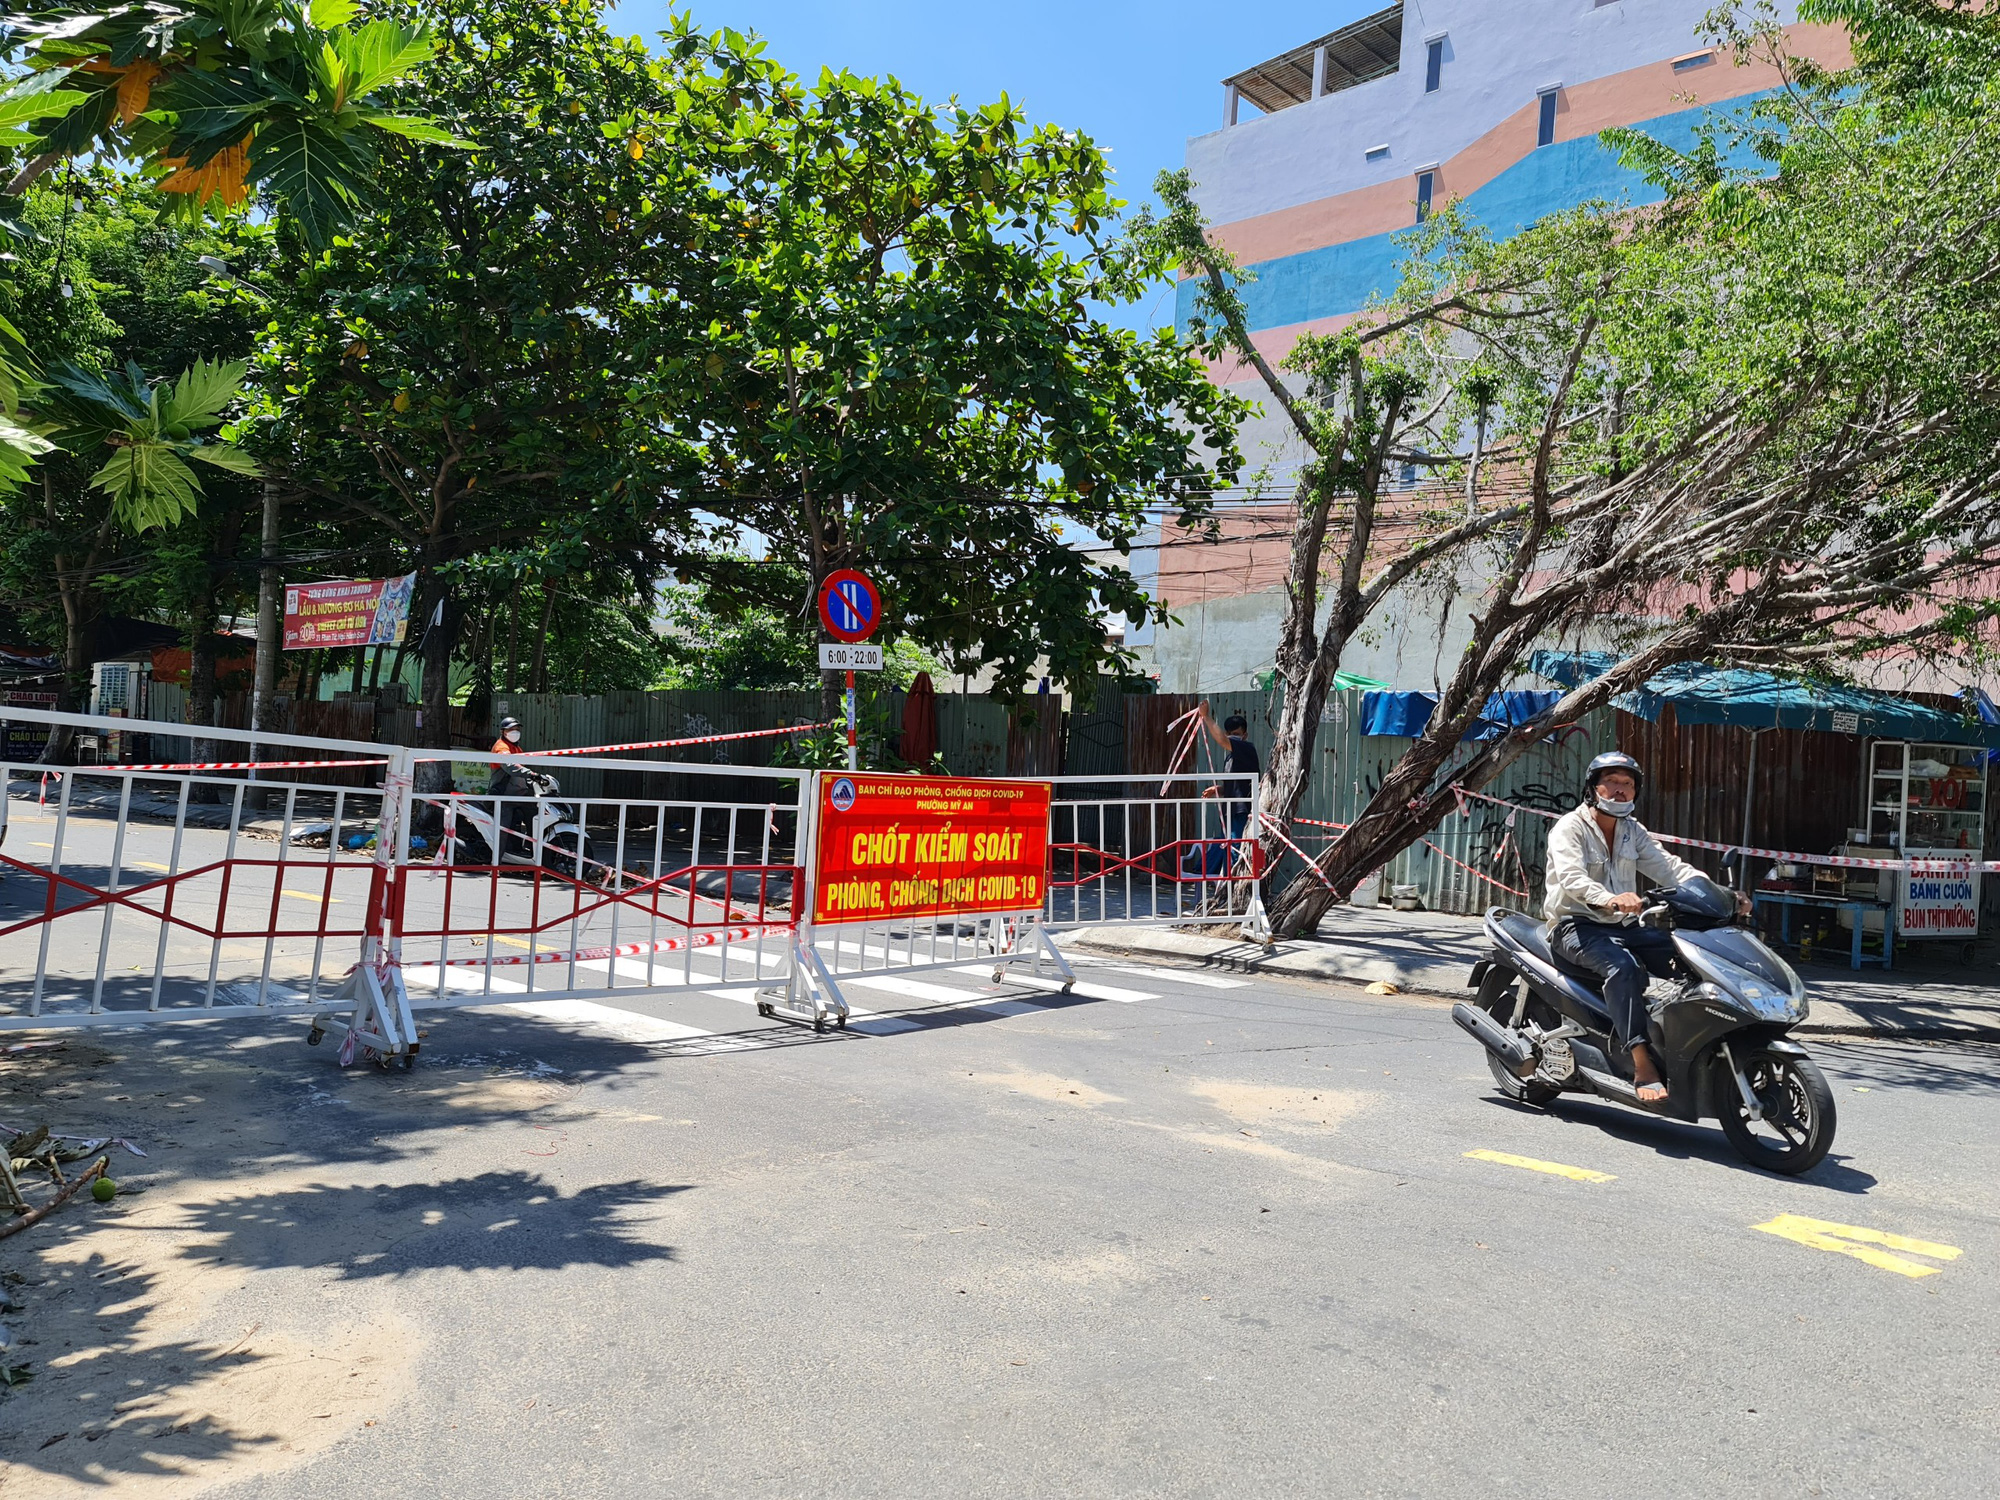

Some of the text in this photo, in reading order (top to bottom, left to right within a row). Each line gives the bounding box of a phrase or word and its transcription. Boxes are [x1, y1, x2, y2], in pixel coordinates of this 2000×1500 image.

[829, 650, 846, 663] 6:00
[855, 651, 877, 664] 22:00
[858, 783, 1024, 799] BAN CHỈ ĐẠO PHÒNG, CHỐNG DỊCH COVID-19
[916, 799, 973, 811] PHƯỜNG MỸ AN
[852, 820, 1022, 865] CHỐT KIỂM SOÁT
[827, 870, 1036, 911] PHÒNG, CHỐNG DỊCH COVID-19
[1910, 878, 1972, 899] BÁNH CUỐN
[1904, 902, 1925, 929] BÚN
[1704, 1006, 1737, 1022] HONDA
